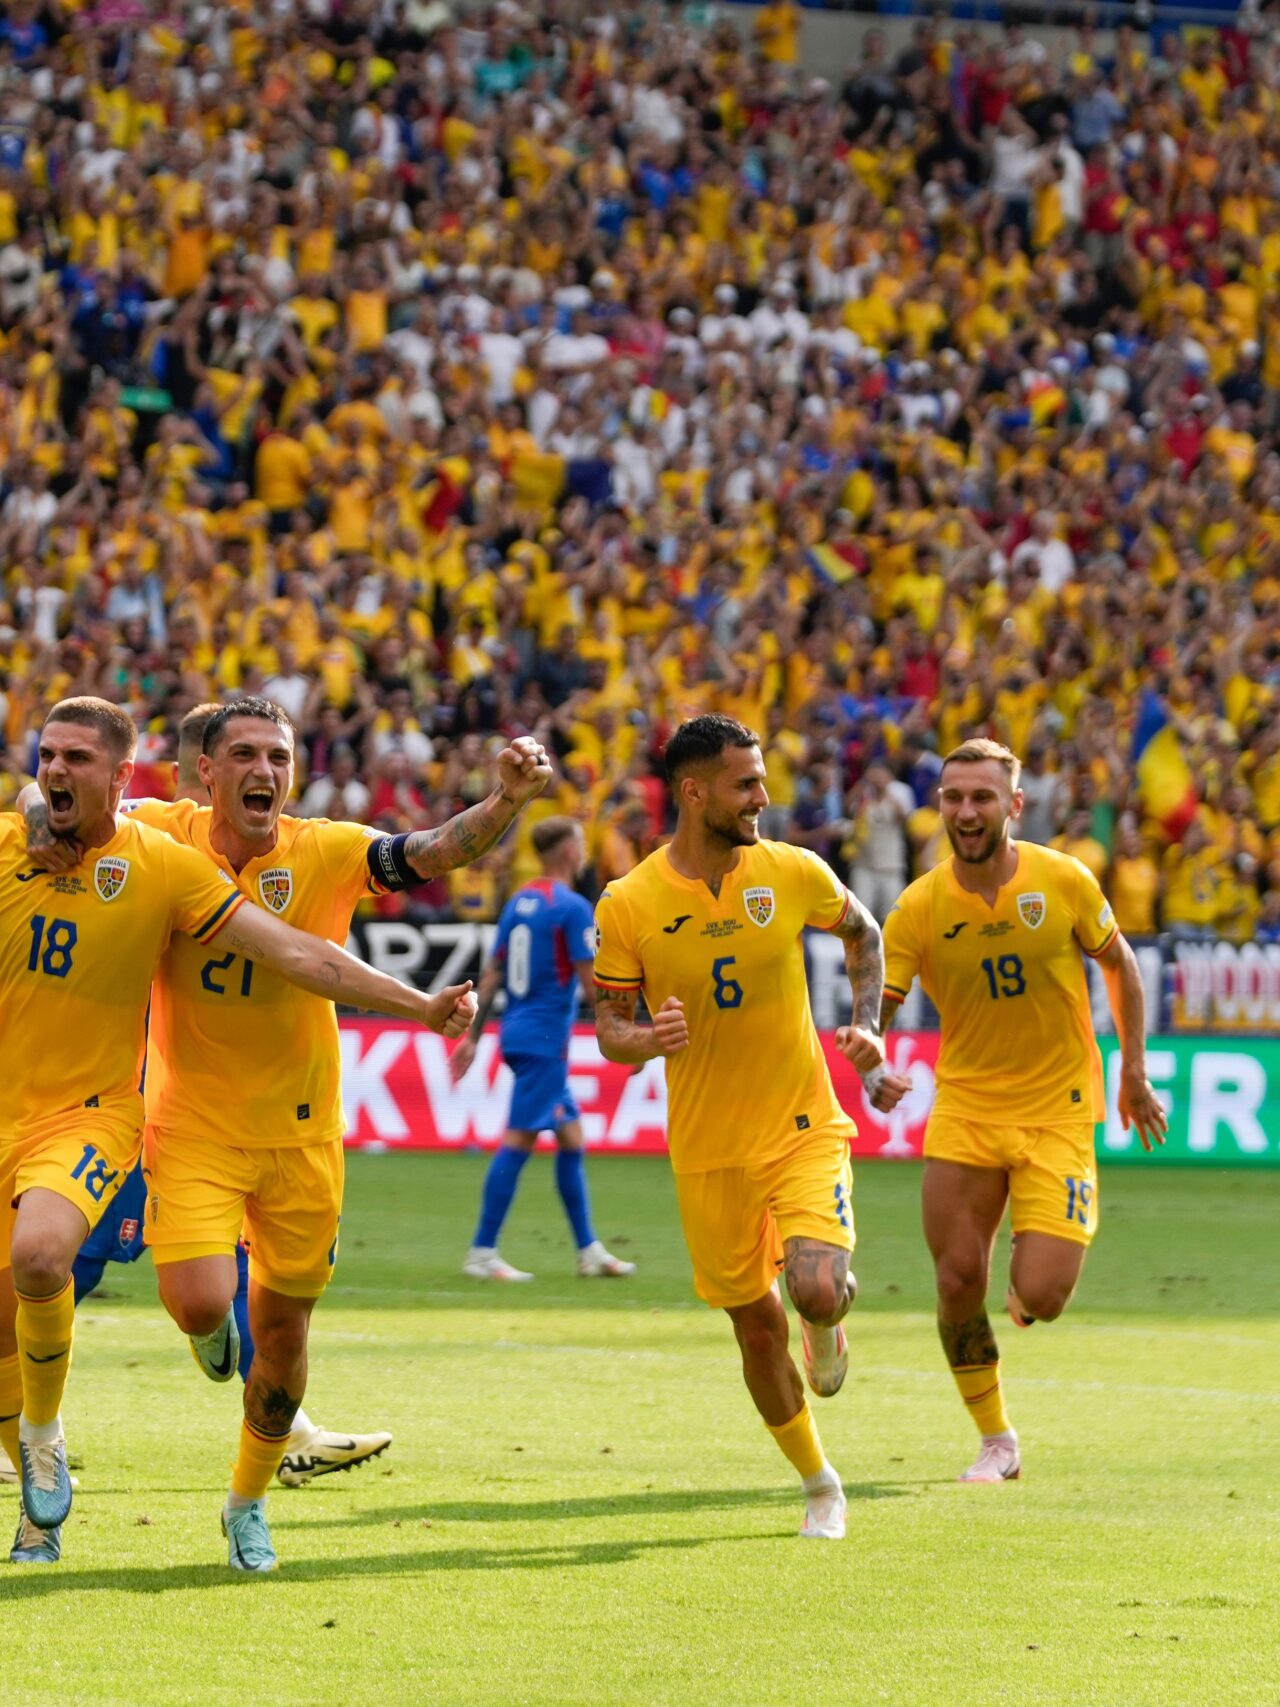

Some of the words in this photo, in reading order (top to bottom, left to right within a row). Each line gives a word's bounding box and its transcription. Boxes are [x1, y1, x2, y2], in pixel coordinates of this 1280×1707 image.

[99, 858, 128, 869] ROMÂNIA
[260, 868, 289, 880] ROMÂNIA
[381, 835, 394, 871] RESPEC
[28, 914, 78, 978] 18
[201, 951, 253, 997] 21
[712, 956, 744, 1009] 6
[982, 953, 1026, 999] 19
[1103, 1050, 1280, 1154] FR
[70, 1144, 119, 1202] 18
